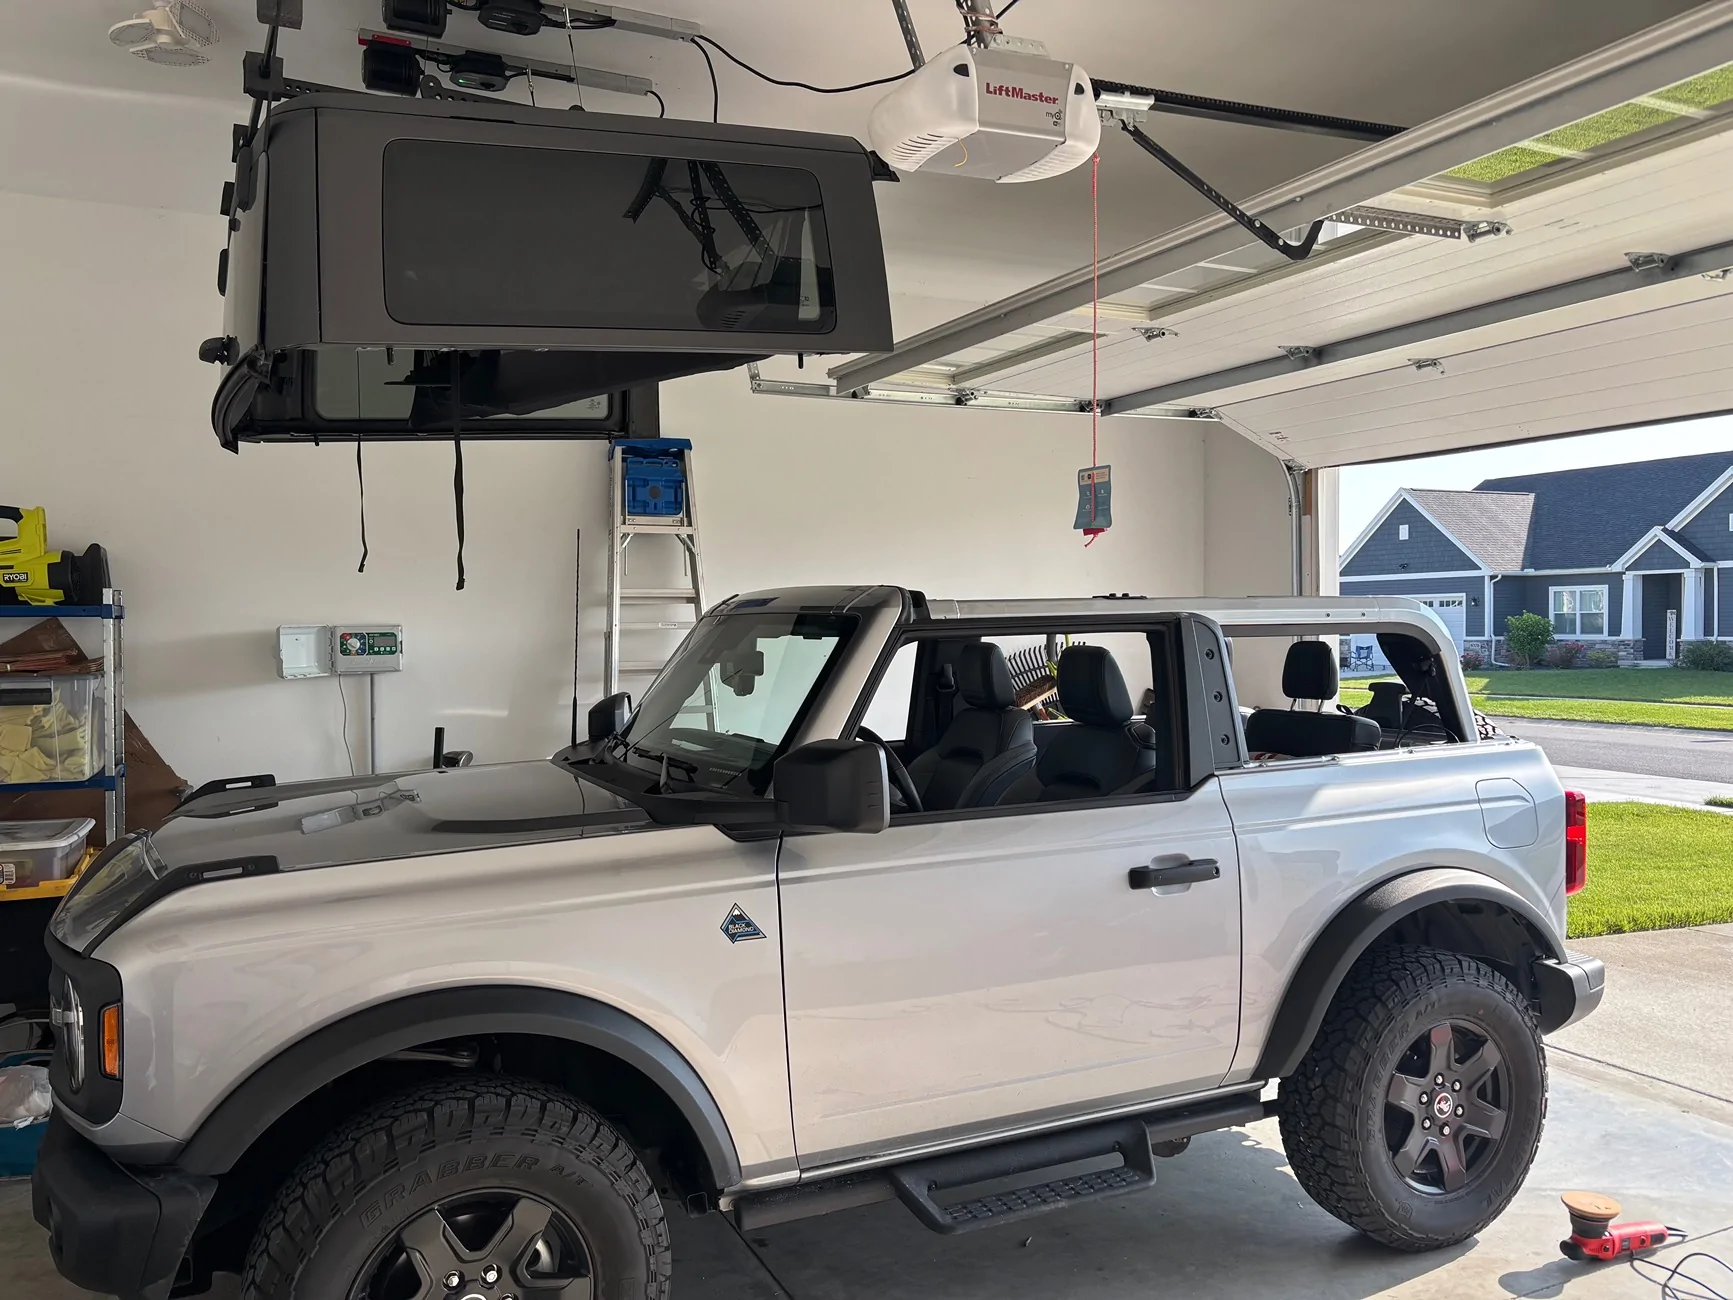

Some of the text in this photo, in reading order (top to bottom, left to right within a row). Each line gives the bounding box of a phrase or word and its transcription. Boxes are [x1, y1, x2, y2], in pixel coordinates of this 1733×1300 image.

[985, 82, 1059, 105] LiftMaster
[3, 573, 27, 581] RYOBI
[359, 1152, 590, 1229] GRABBER A/T
